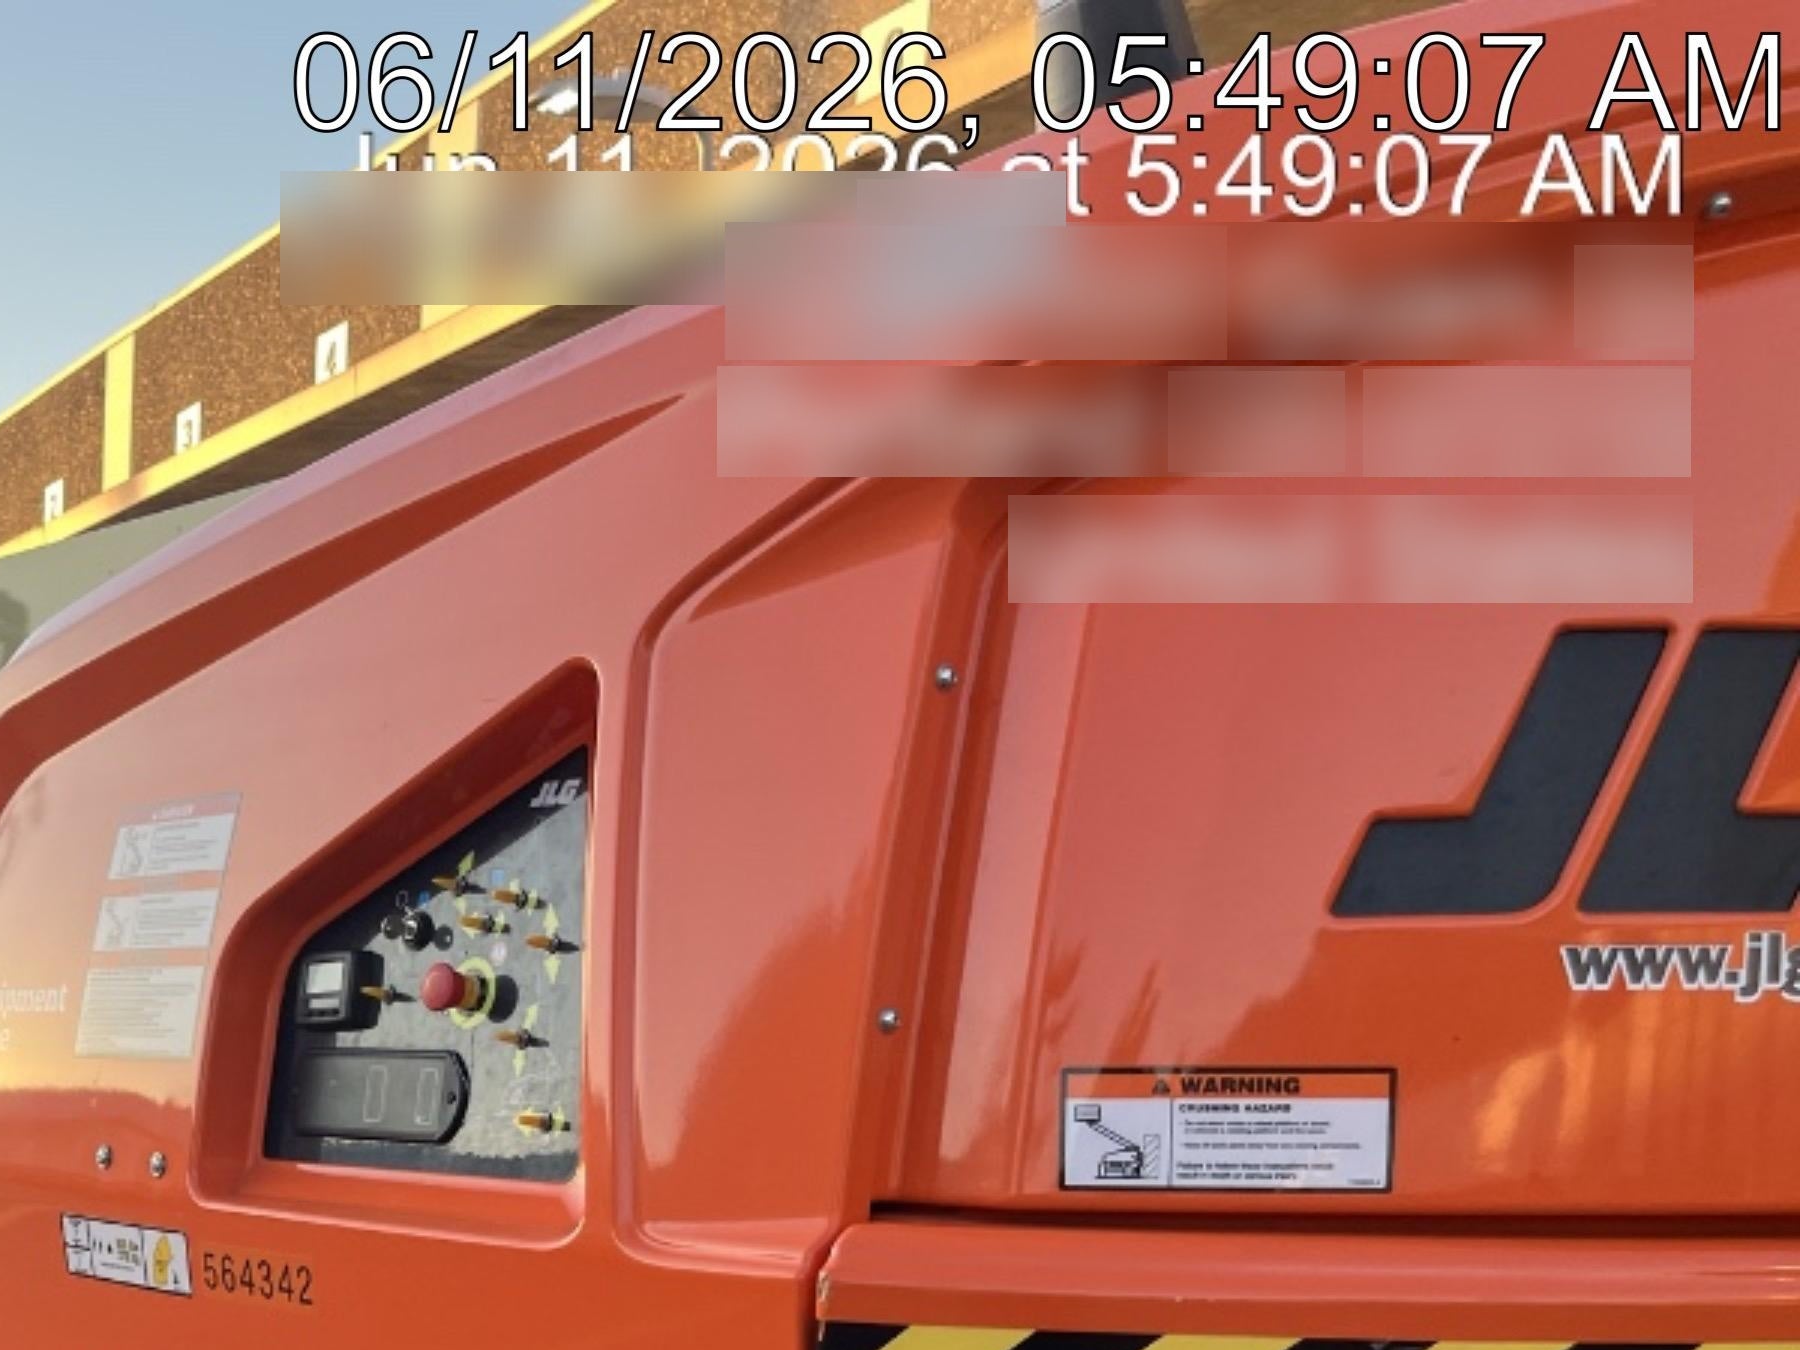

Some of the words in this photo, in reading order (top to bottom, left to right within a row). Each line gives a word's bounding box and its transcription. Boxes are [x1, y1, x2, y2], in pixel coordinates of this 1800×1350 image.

[530, 778, 581, 808] JLG
[1181, 1077, 1300, 1095] WARNING
[203, 1253, 313, 1305] 564342
